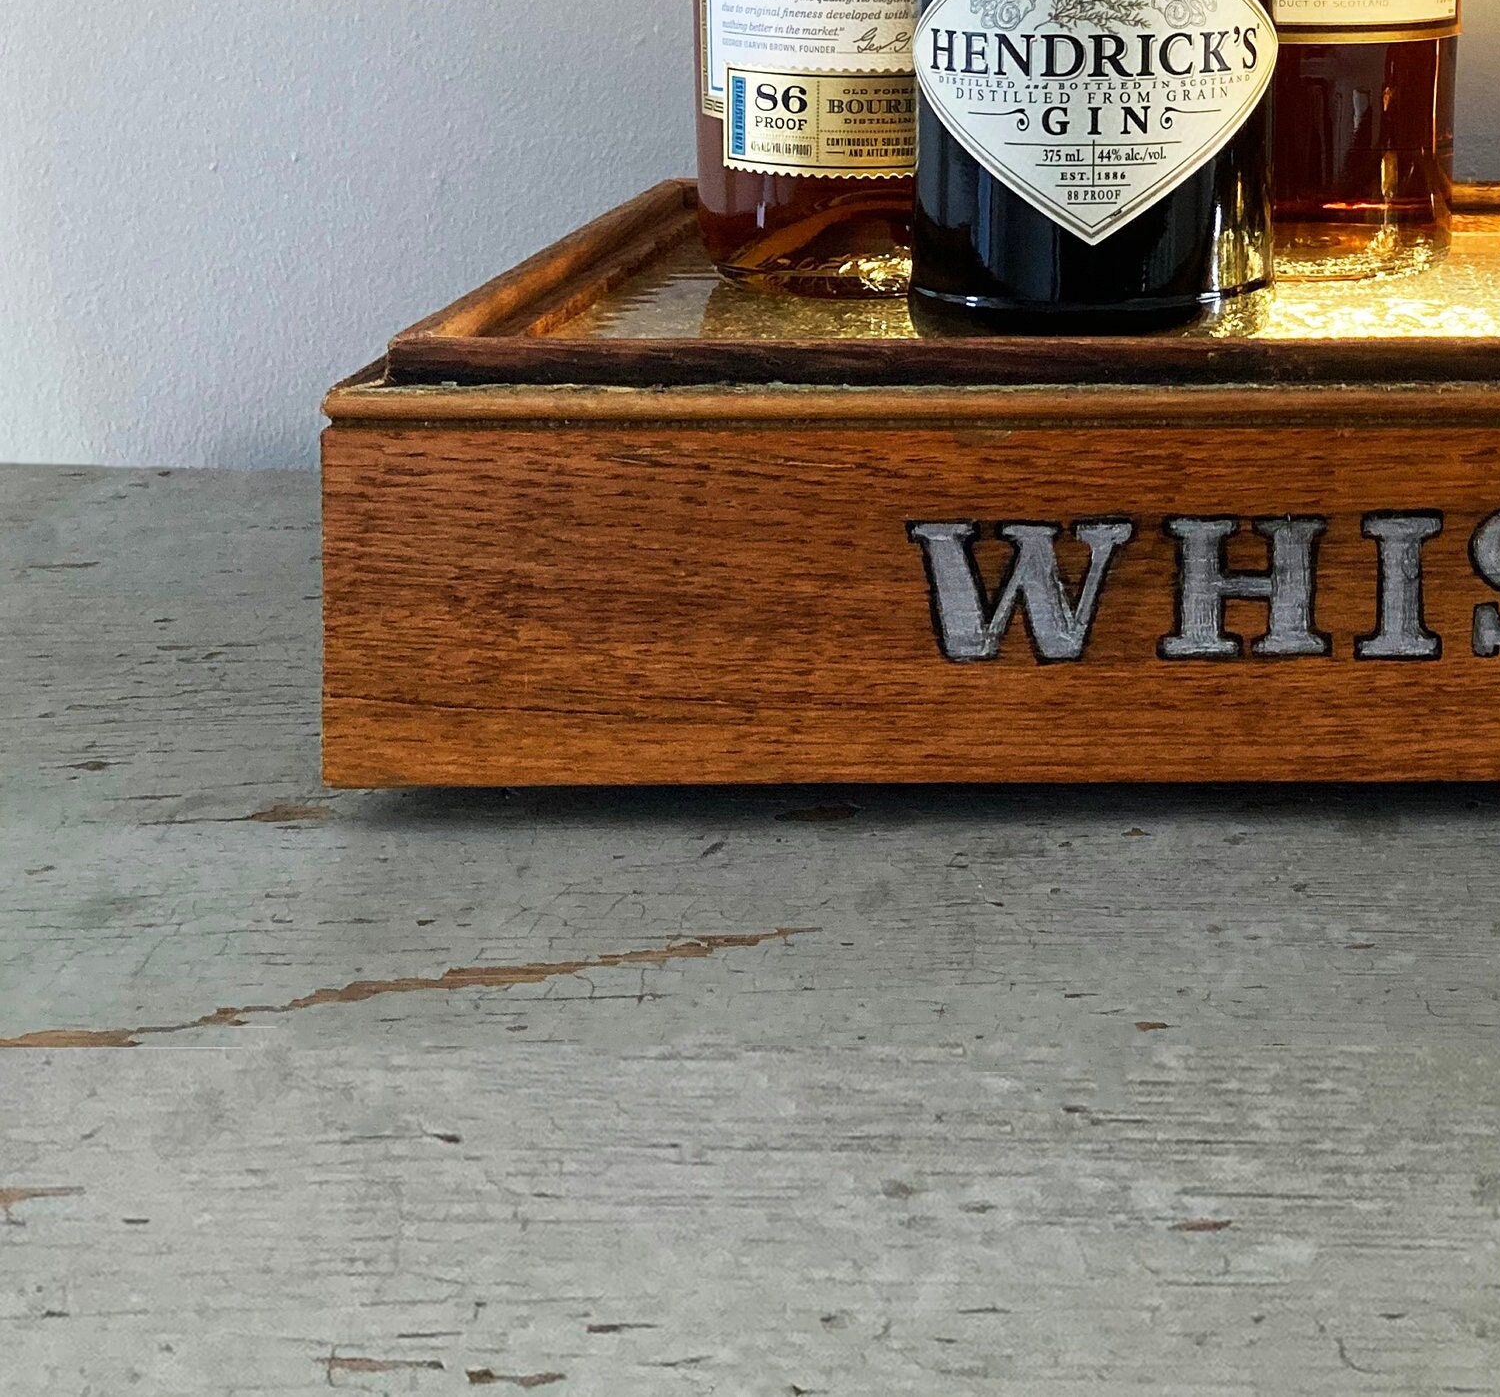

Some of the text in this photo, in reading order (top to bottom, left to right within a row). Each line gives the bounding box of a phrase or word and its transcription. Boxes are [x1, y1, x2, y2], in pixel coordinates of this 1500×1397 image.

[745, 6, 909, 22] original fineness developed with
[775, 24, 784, 34] in
[786, 25, 799, 35] the
[799, 44, 836, 55] FOUNDER
[930, 26, 1258, 80] HENDRICK'S
[938, 74, 1251, 90] DISTILLED and BOTTLED IN SCOTLAND
[755, 83, 808, 114] 86
[955, 86, 1229, 104] DISTILLED FROM GRAIN
[755, 116, 808, 131] PROOF
[1041, 106, 1152, 136] GIN
[1042, 146, 1168, 163] 375 mL 44% alc./vol.
[1060, 171, 1126, 181] EST. 1886
[1067, 188, 1121, 202] 88 PROOF
